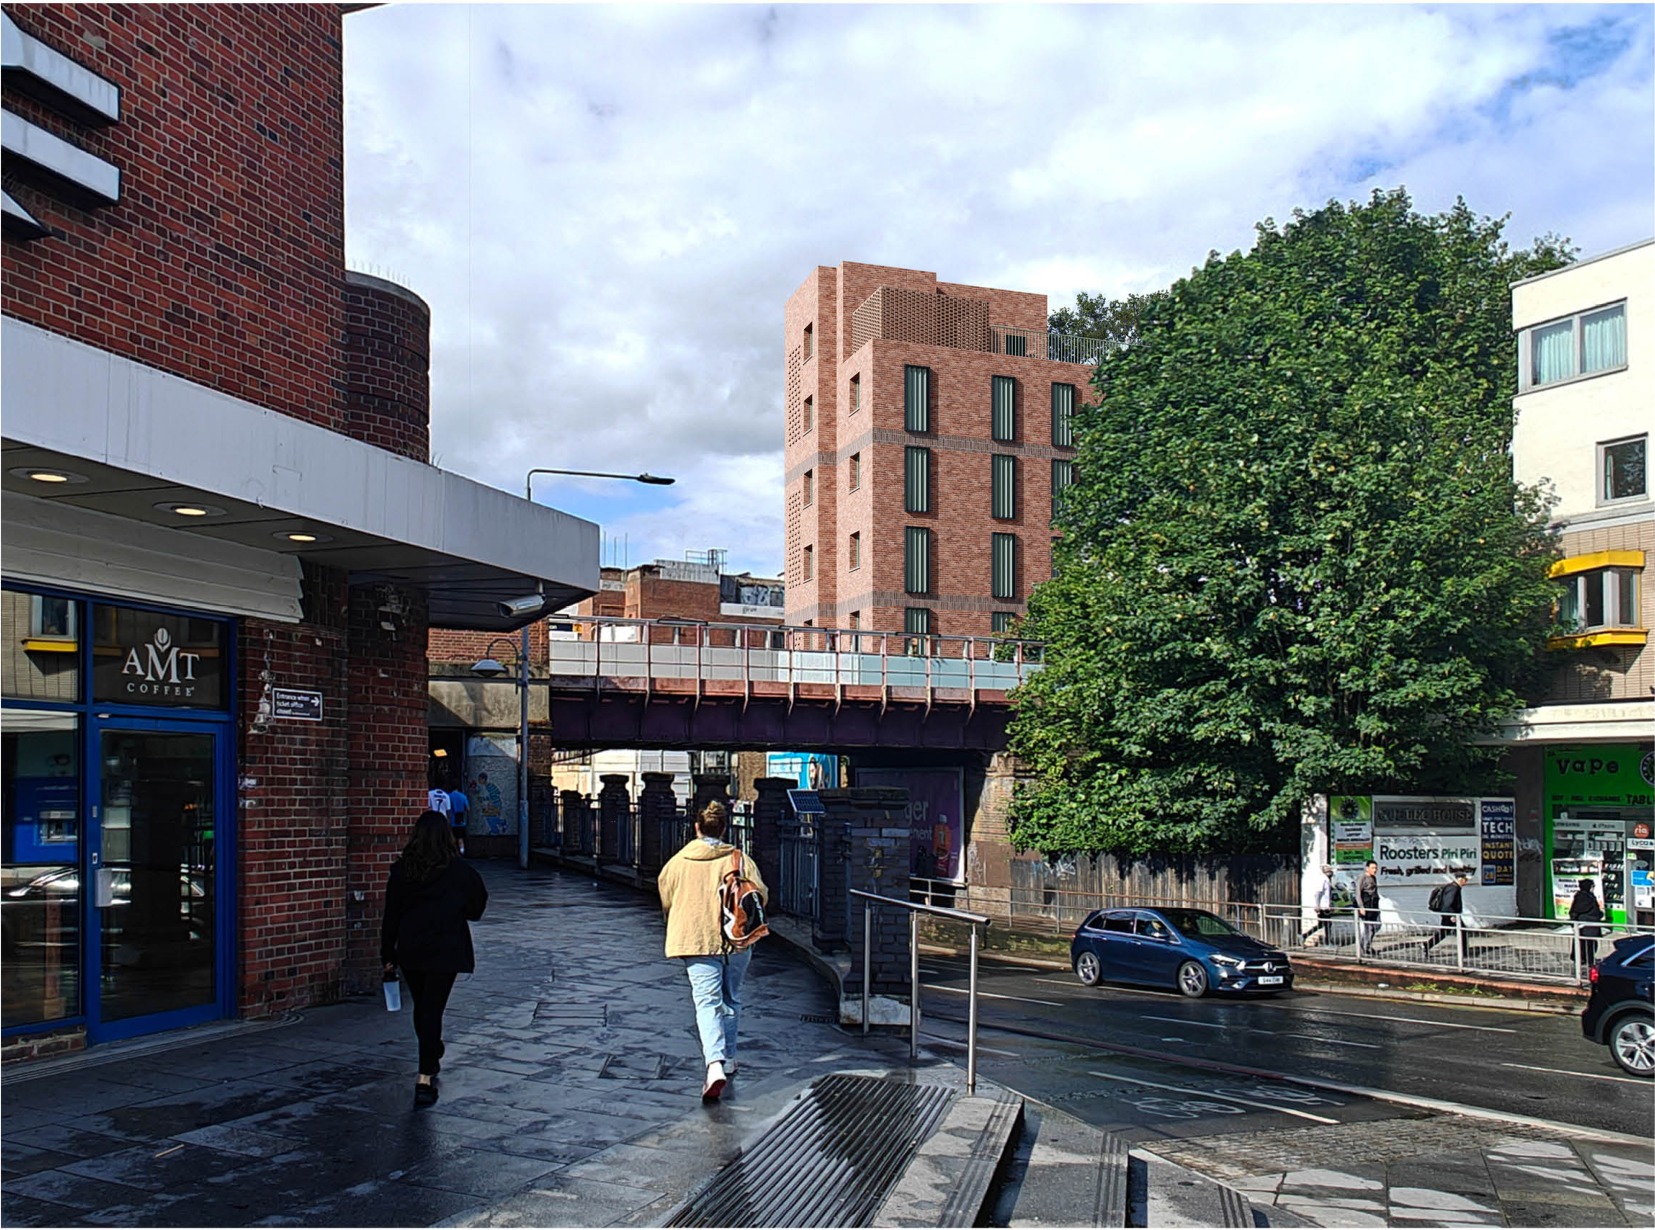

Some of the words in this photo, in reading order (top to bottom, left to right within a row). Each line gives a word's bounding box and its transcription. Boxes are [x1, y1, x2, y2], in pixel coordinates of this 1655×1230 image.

[122, 643, 200, 684] AMT
[127, 682, 192, 697] COFFEE
[1625, 794, 1654, 806] TABL
[1432, 808, 1474, 821] HOUSE
[1482, 821, 1513, 833] TECH
[1482, 842, 1513, 850] INSTANT
[1380, 845, 1439, 861] Roosters
[1441, 847, 1459, 859] Piri
[1460, 847, 1477, 859] Piri
[1482, 851, 1513, 860] QUOTE
[1381, 866, 1404, 876] Fresh,
[1405, 866, 1432, 877] grilled
[1433, 865, 1447, 875] and
